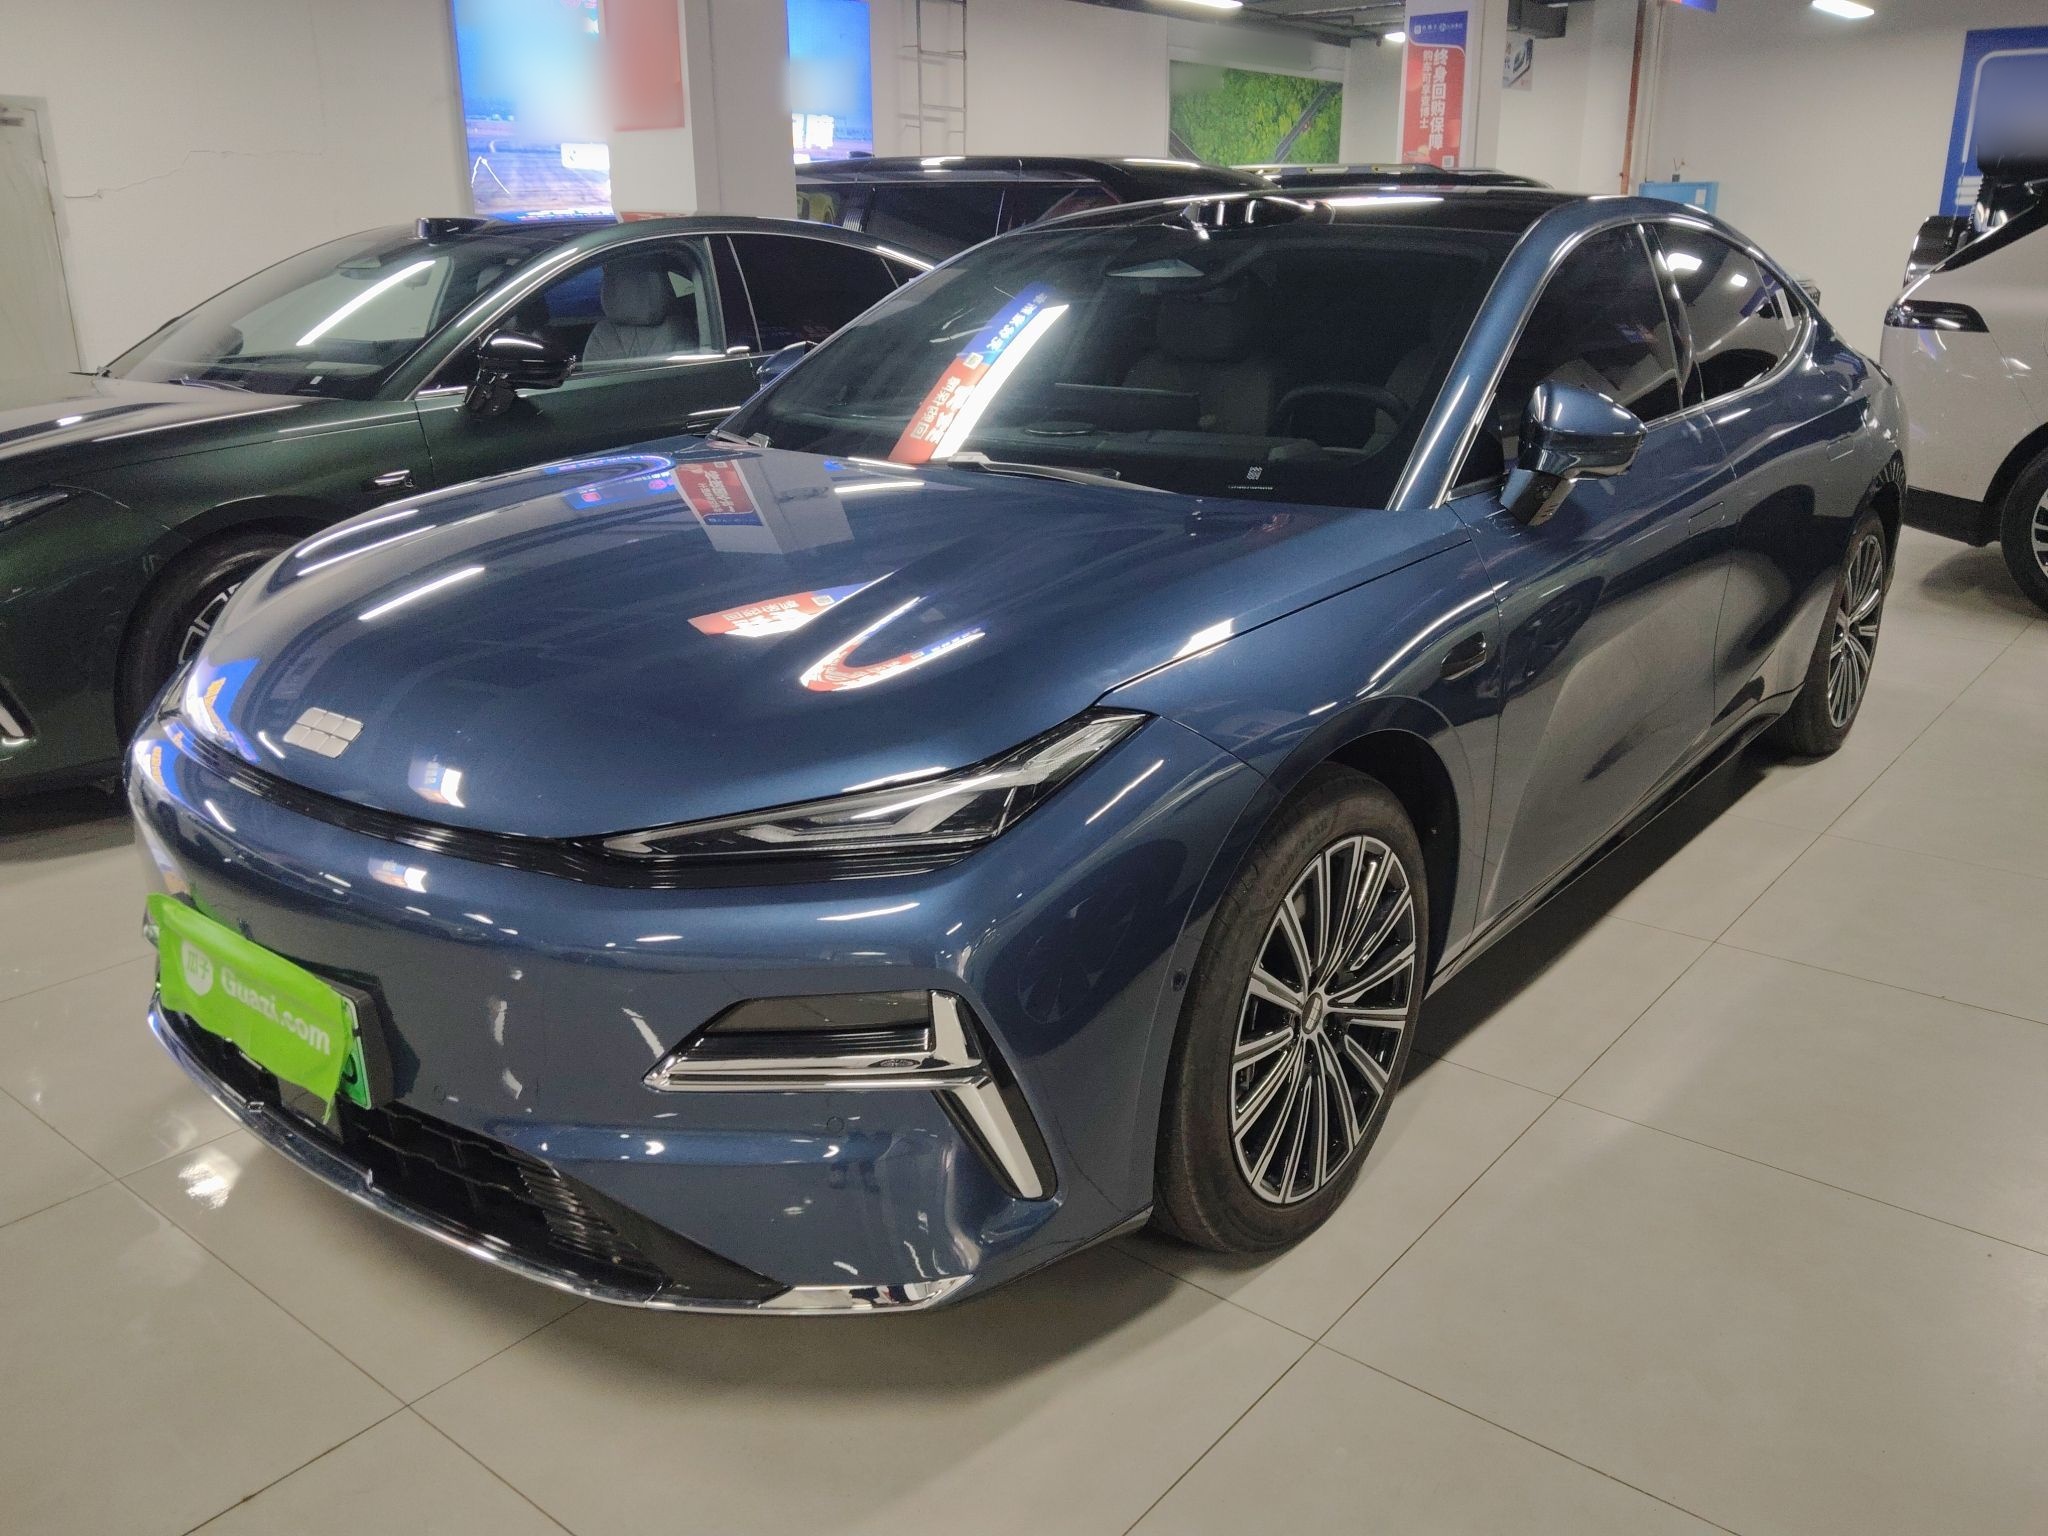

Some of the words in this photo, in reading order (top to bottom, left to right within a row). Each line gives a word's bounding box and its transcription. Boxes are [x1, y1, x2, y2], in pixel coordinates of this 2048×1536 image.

[1428, 48, 1448, 150] 终身回购保障
[220, 966, 331, 1055] Guazi.com
